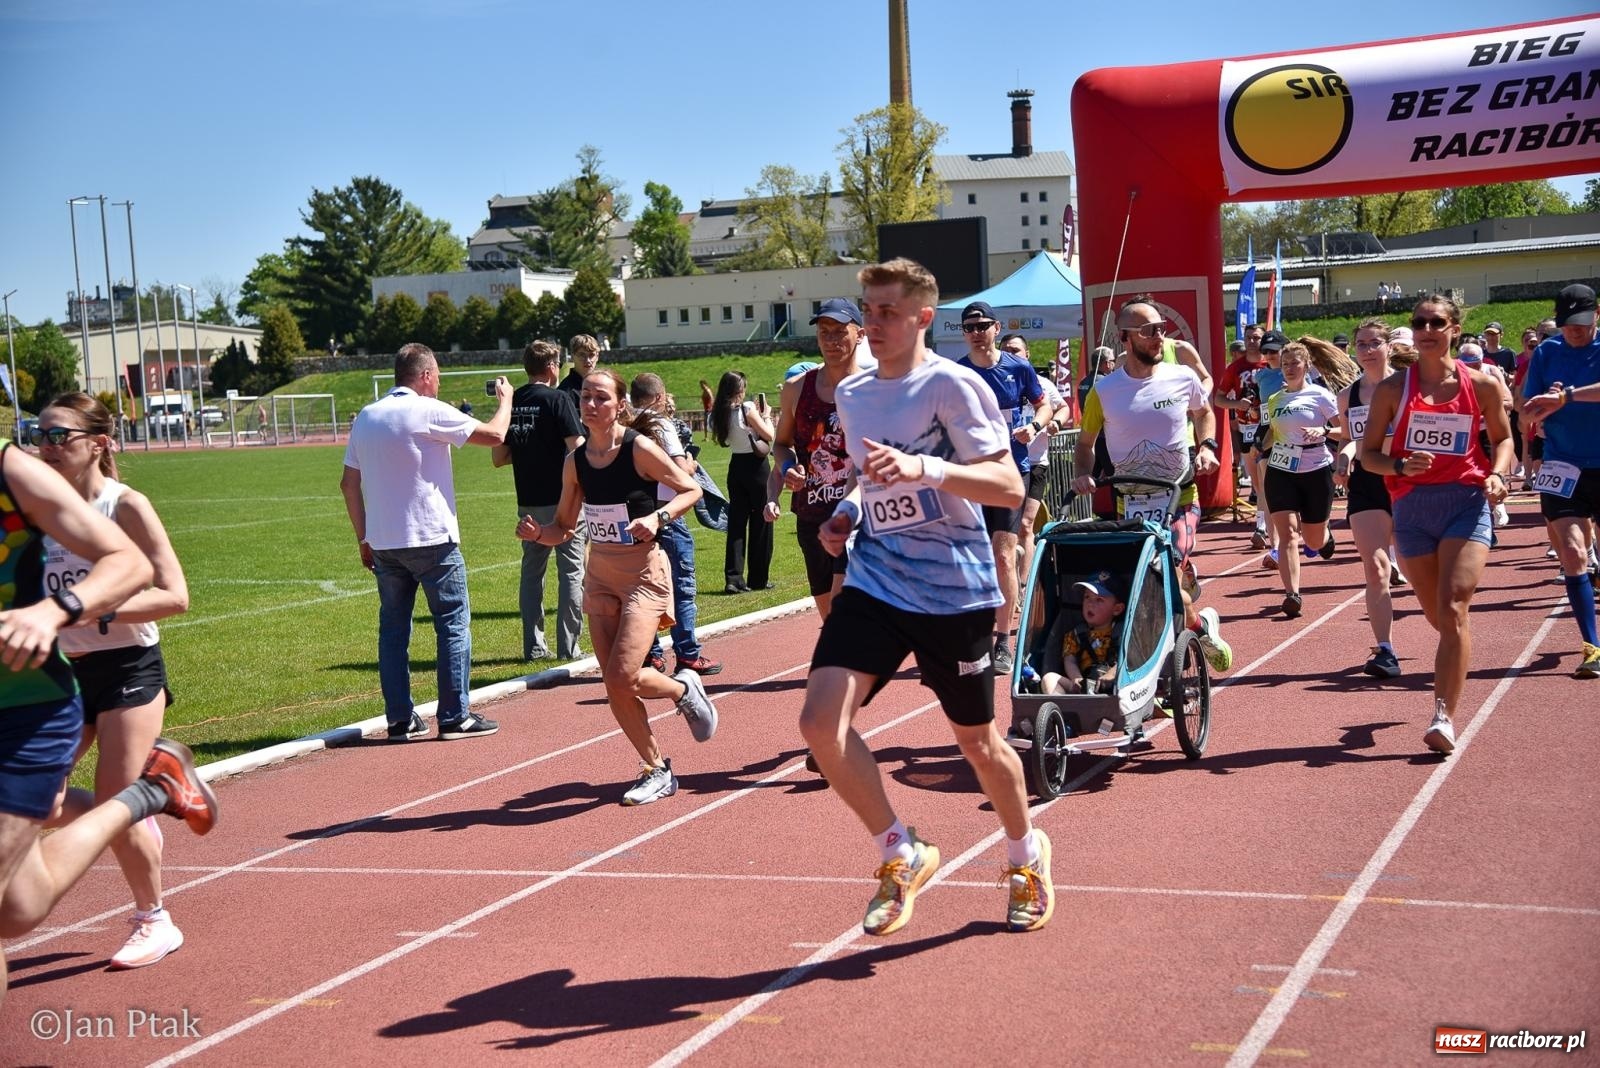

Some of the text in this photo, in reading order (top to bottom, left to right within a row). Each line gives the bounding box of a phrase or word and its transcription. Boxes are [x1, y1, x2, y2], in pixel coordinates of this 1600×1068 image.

[1468, 31, 1586, 67] BIEG
[1286, 75, 1350, 99] SIR
[1387, 83, 1481, 121] BEZ
[1413, 429, 1452, 447] 058
[1271, 452, 1290, 466] 074
[1538, 474, 1562, 488] 079
[873, 495, 917, 523] 033
[590, 521, 618, 538] 054
